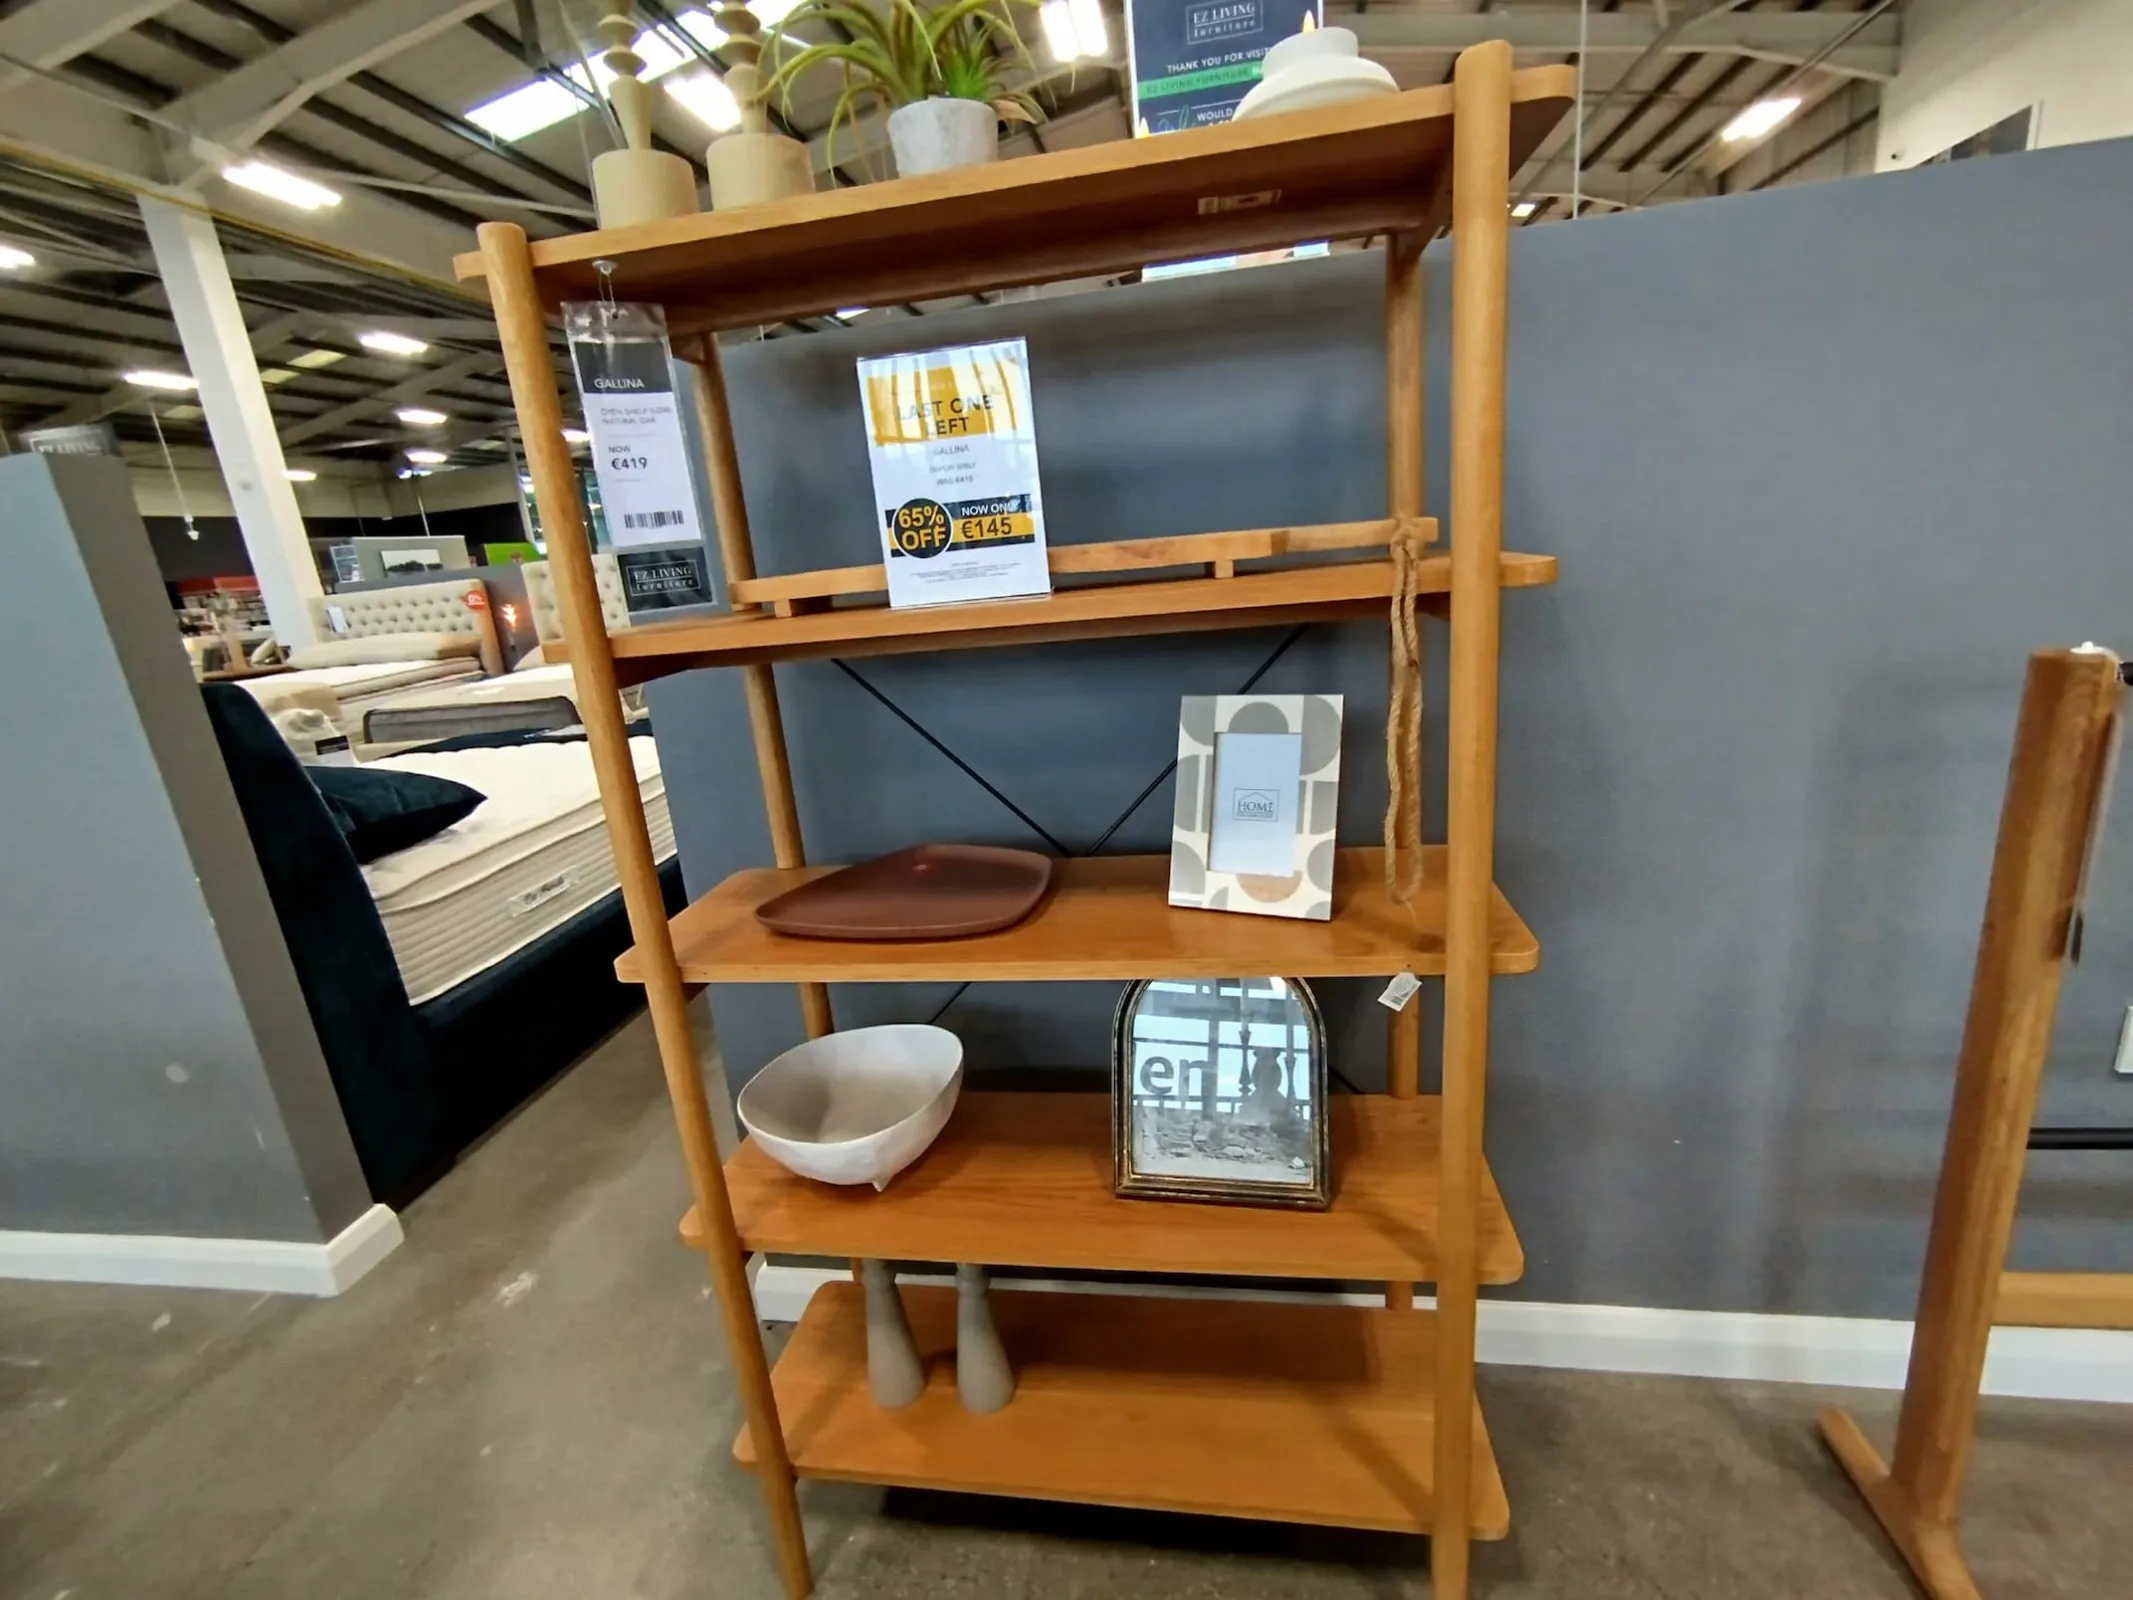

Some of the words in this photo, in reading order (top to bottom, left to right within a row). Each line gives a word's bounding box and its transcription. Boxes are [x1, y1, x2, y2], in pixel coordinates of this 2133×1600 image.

[1193, 10, 1210, 24] EZ
[1212, 2, 1256, 20] LIVING
[1194, 20, 1257, 38] furniture
[1167, 60, 1199, 74] THANK
[1201, 56, 1222, 68] YOU
[1224, 50, 1244, 62] FOR
[1197, 108, 1233, 122] WOULD
[594, 378, 646, 389] GALLINA
[896, 400, 943, 421] LAST
[950, 394, 993, 414] ONE
[608, 446, 631, 454] NOW
[611, 456, 648, 471] €419
[898, 504, 945, 529] 65%
[961, 504, 988, 517] NOW
[960, 516, 1013, 540] €145
[901, 526, 947, 550] OFF
[634, 570, 648, 580] EZ
[651, 566, 692, 579] LIVING
[636, 579, 694, 591] furniture
[1237, 801, 1275, 813] HOME
